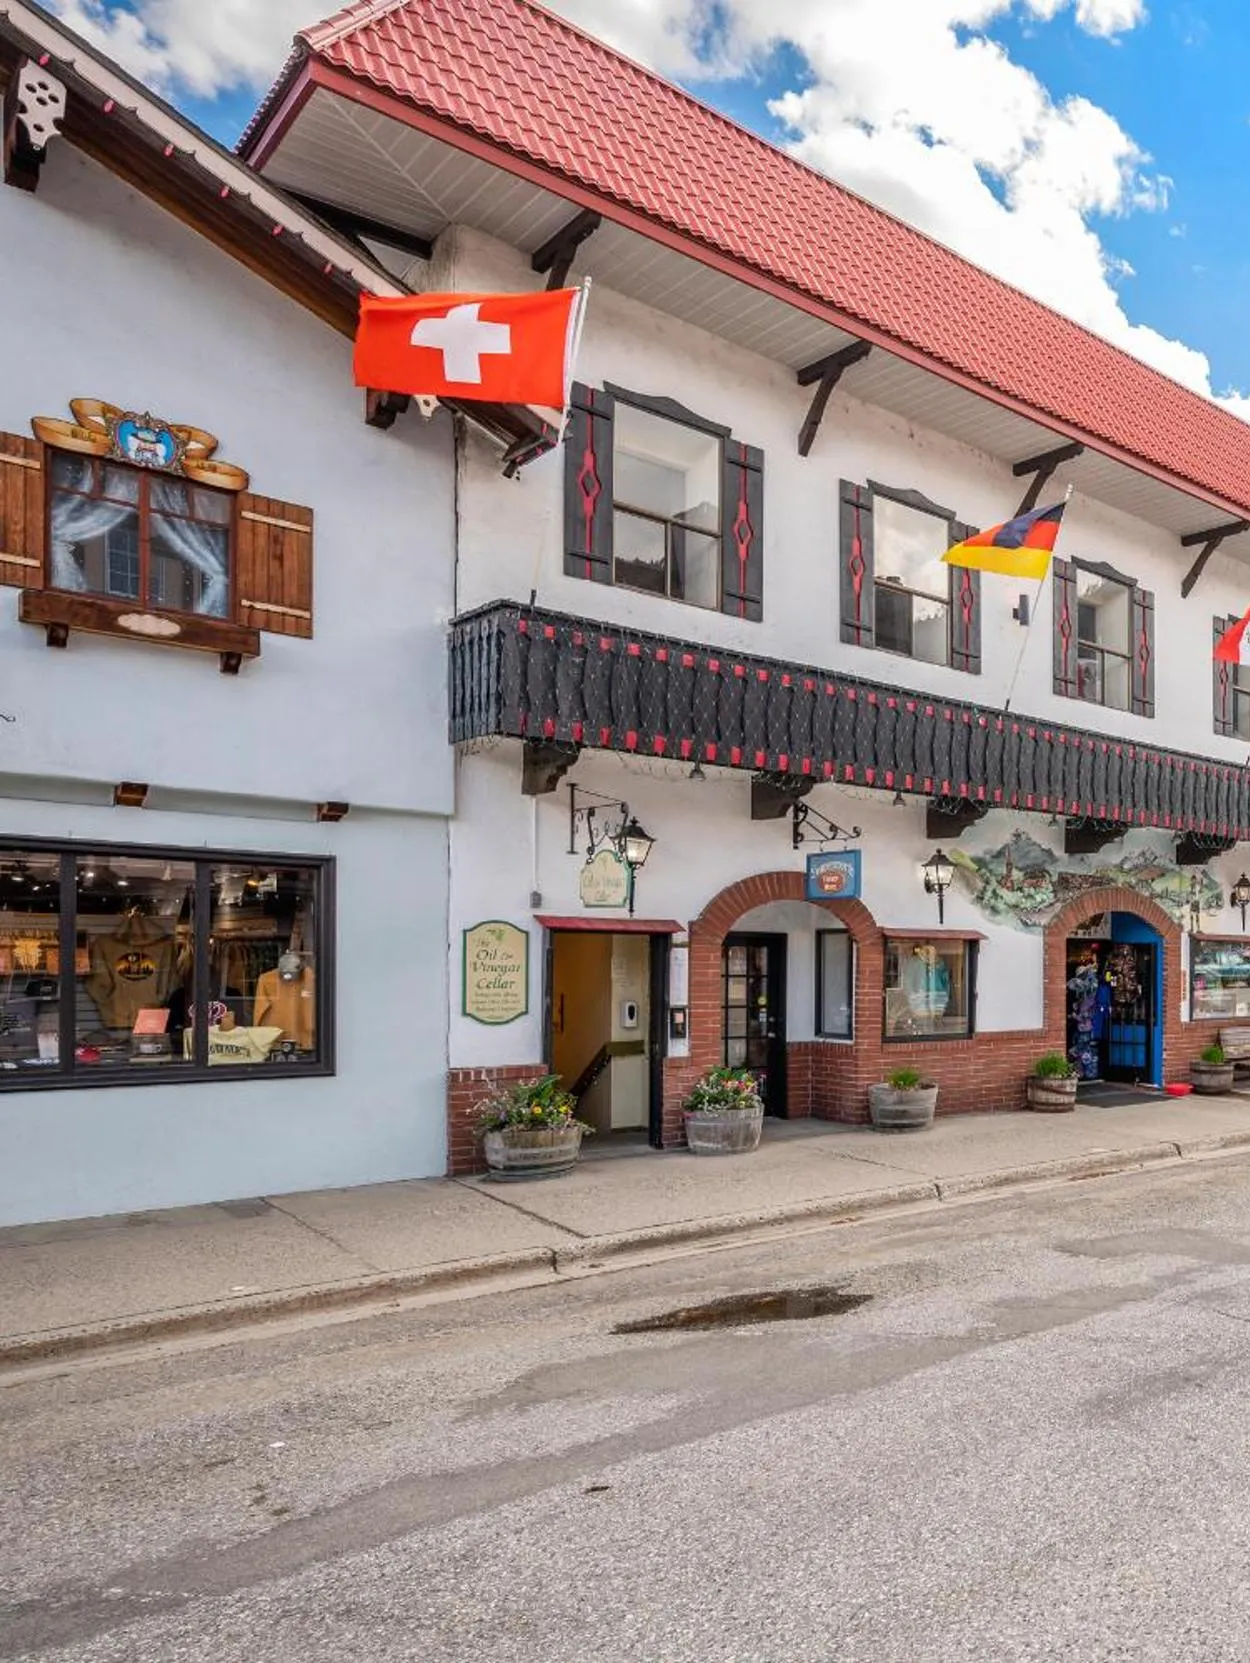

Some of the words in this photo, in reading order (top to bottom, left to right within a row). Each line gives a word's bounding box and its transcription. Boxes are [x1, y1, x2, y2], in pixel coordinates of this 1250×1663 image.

[475, 948, 498, 961] Oil
[472, 961, 521, 976] Vinegar
[475, 975, 516, 990] Cellar
